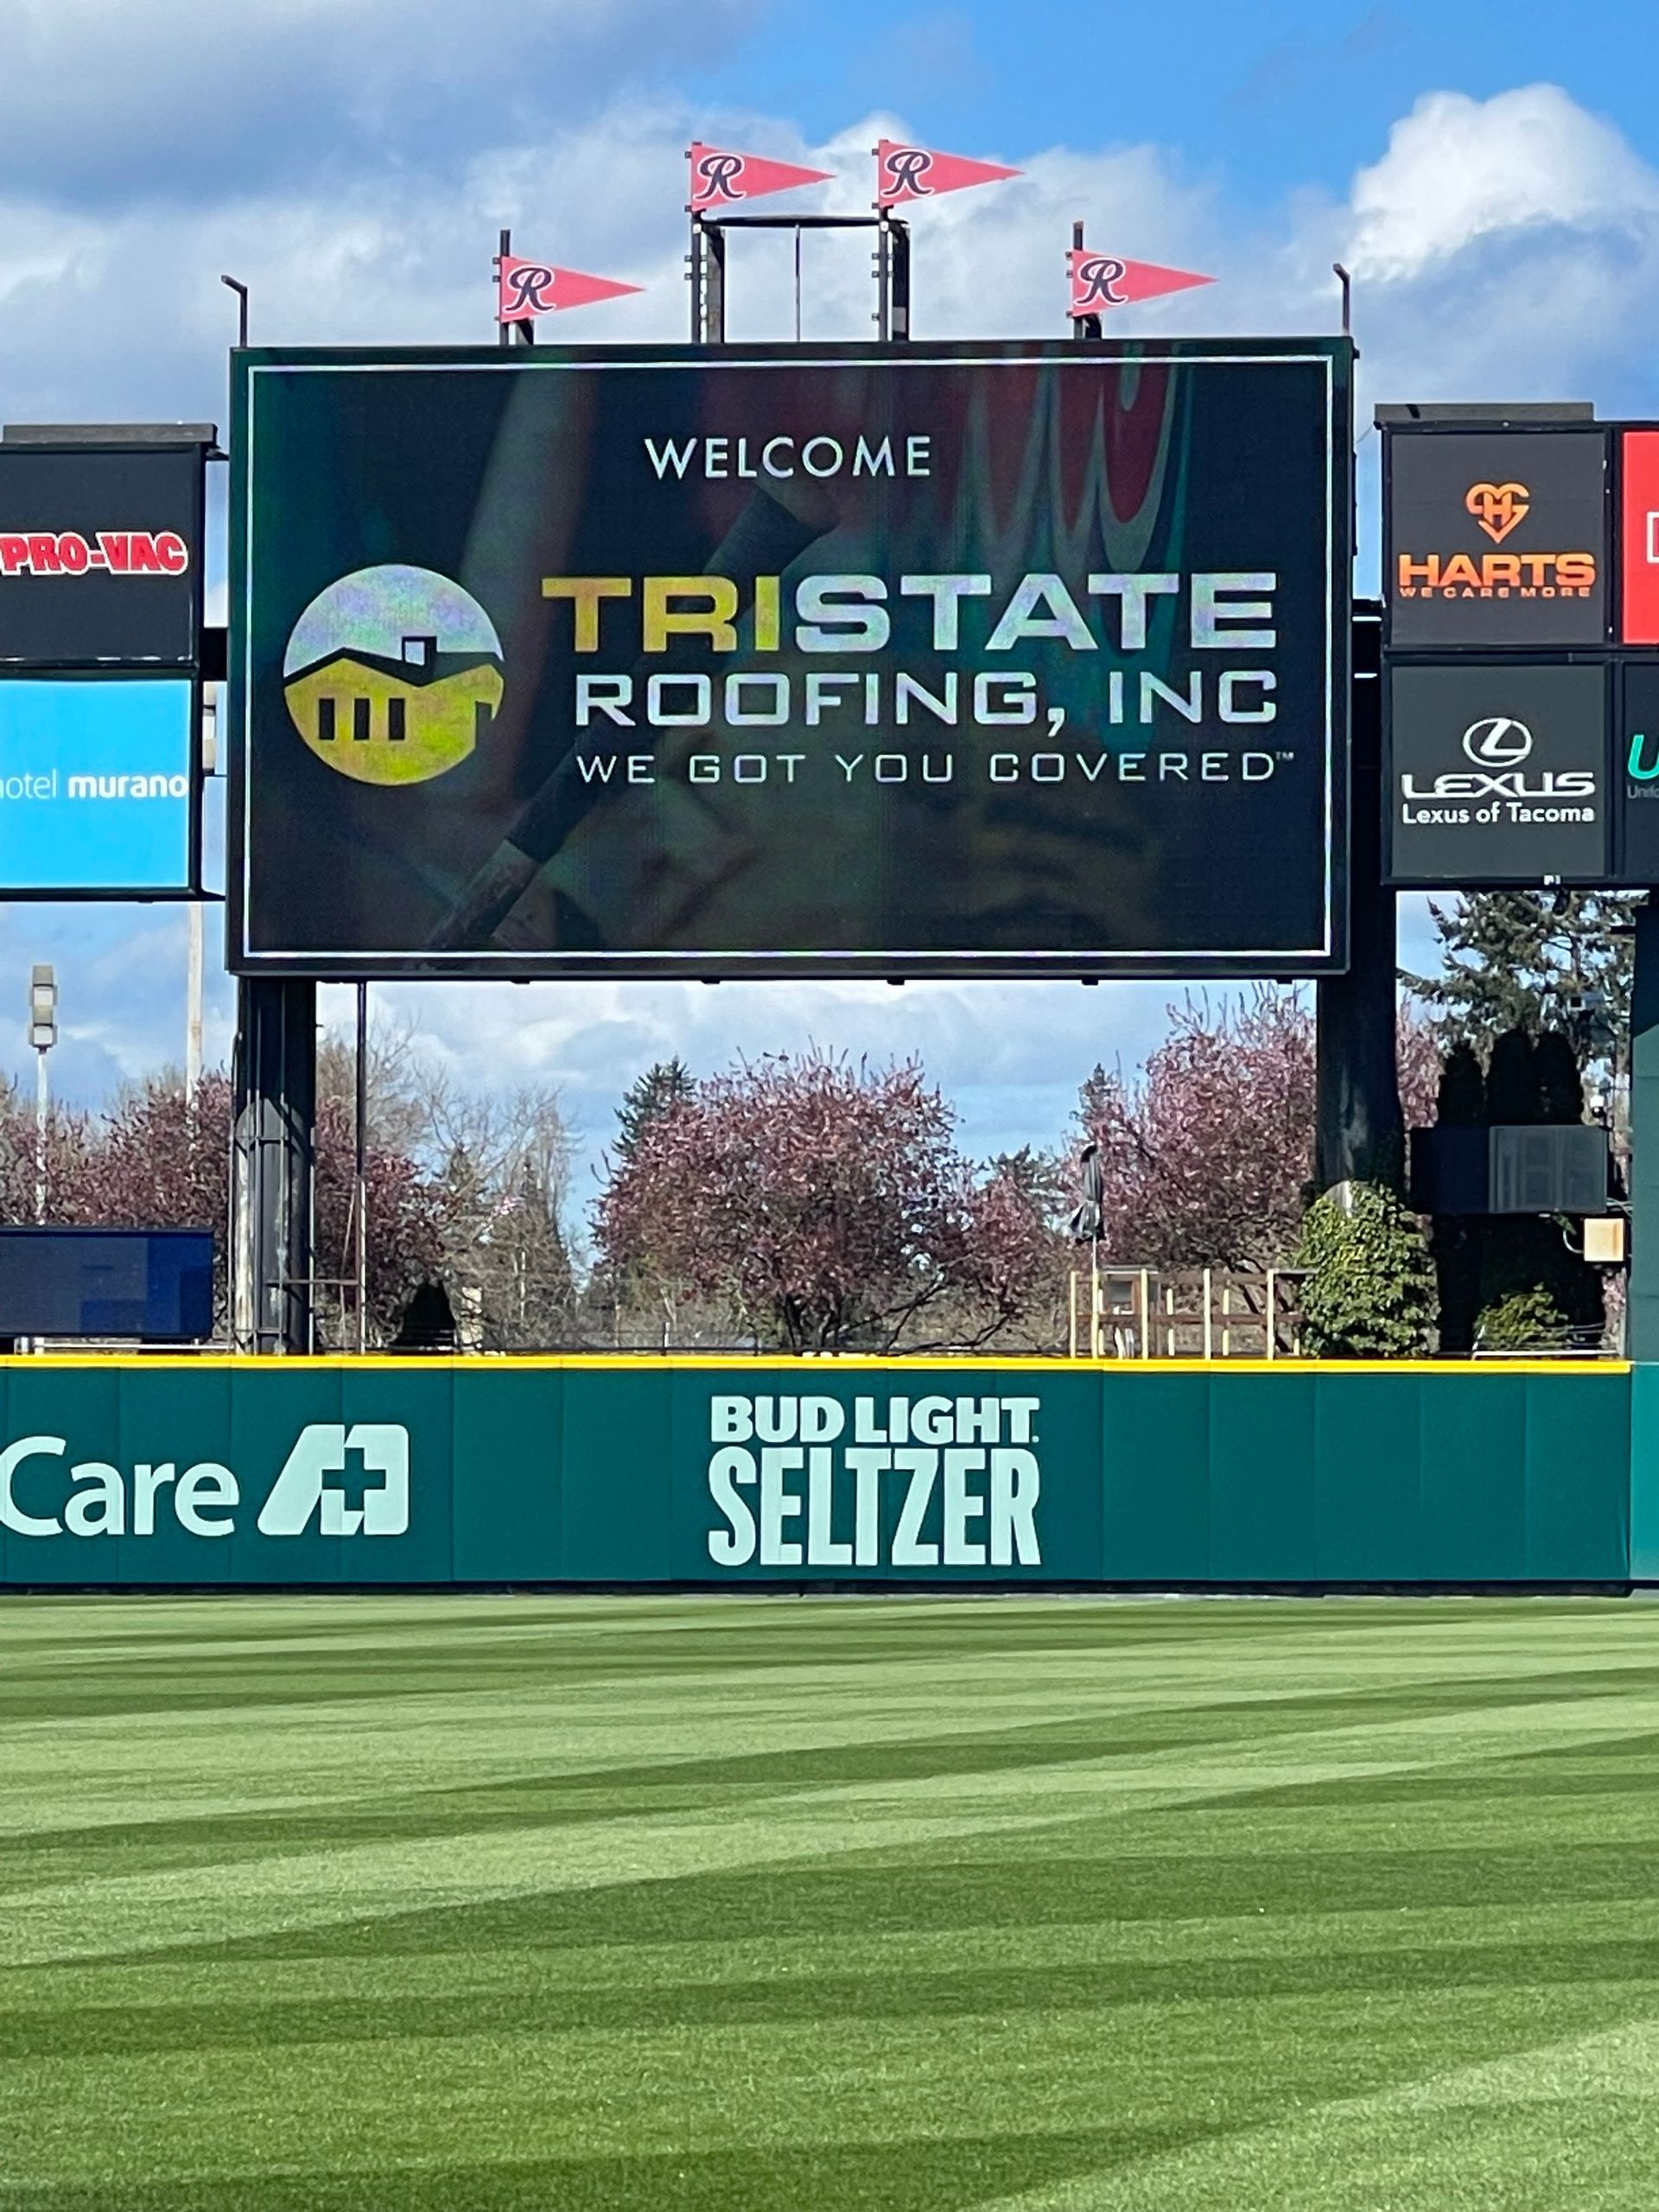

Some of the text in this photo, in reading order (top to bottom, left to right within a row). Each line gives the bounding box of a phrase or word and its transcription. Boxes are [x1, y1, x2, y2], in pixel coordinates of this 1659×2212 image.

[696, 153, 746, 200] R
[883, 149, 933, 197] R
[505, 264, 556, 313] R
[1075, 257, 1128, 306] R
[645, 435, 932, 480] WELCOME
[0, 531, 188, 575] PRO-VAC
[1398, 553, 1596, 587] HARTS
[542, 571, 1278, 653] TRISTATE
[1399, 587, 1592, 598] WE CARE MORE
[575, 670, 1279, 737] ROOFING, INC
[0, 768, 189, 799] otel murano
[576, 754, 655, 783] WE
[689, 753, 806, 783] GOT
[835, 753, 955, 783] YOU
[1401, 772, 1596, 798] LEXUS
[1402, 802, 1595, 823] Lexus of Tacoma
[711, 1395, 845, 1443] BUD
[0, 1435, 240, 1536] Care
[708, 1446, 1042, 1567] SELTZER
